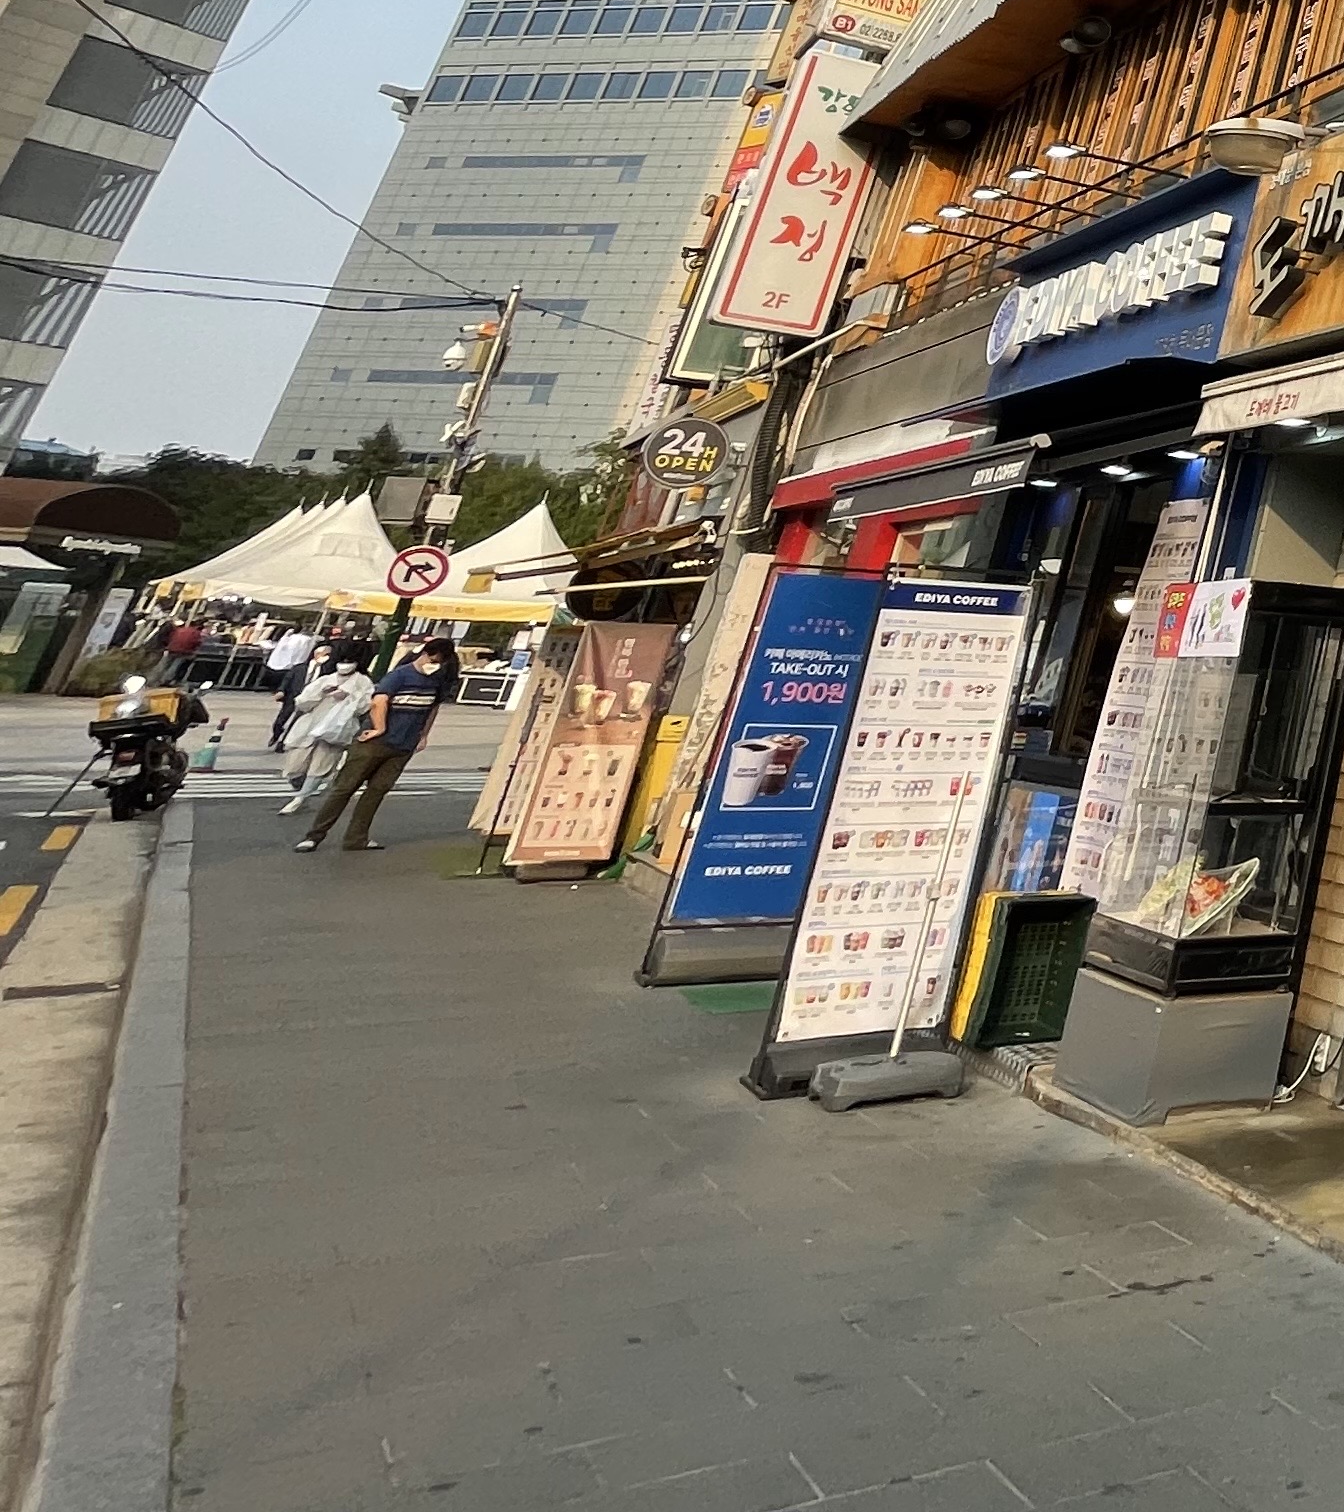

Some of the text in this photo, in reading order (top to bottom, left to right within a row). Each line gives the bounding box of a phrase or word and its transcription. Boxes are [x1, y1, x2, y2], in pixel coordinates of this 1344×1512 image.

[835, 18, 853, 31] B1
[1094, 211, 1233, 321] COFFEE
[762, 291, 791, 309] 2F
[653, 455, 714, 473] OPEN
[914, 592, 998, 607] EDIYA COFFEE
[769, 662, 833, 676] TAKE-OUT
[760, 680, 847, 706] 1,900원
[704, 864, 792, 877] EDIYA COFFEE
